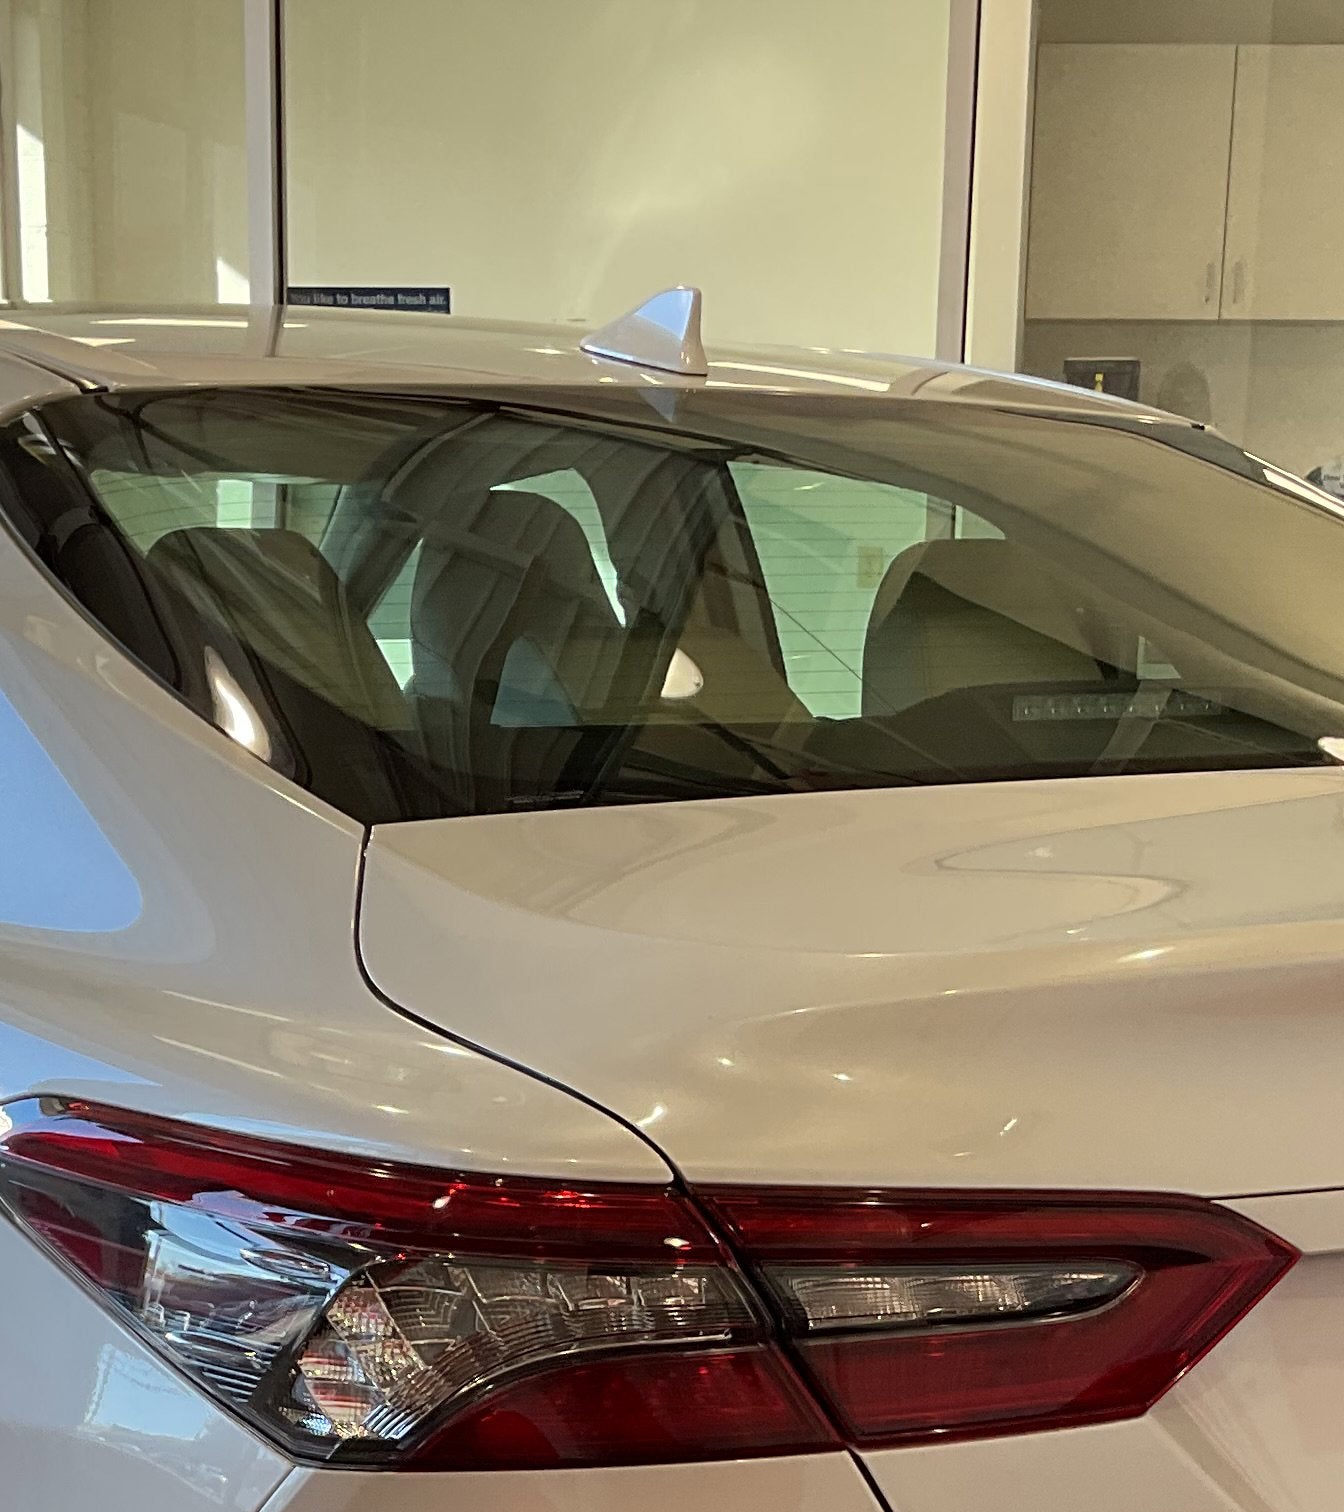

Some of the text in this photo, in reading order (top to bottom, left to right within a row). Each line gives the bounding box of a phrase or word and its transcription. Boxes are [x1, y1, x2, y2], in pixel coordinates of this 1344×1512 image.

[313, 293, 334, 304] like
[336, 293, 349, 305] to
[351, 293, 395, 305] breathe
[398, 293, 426, 305] fresh
[429, 294, 447, 305] air.
